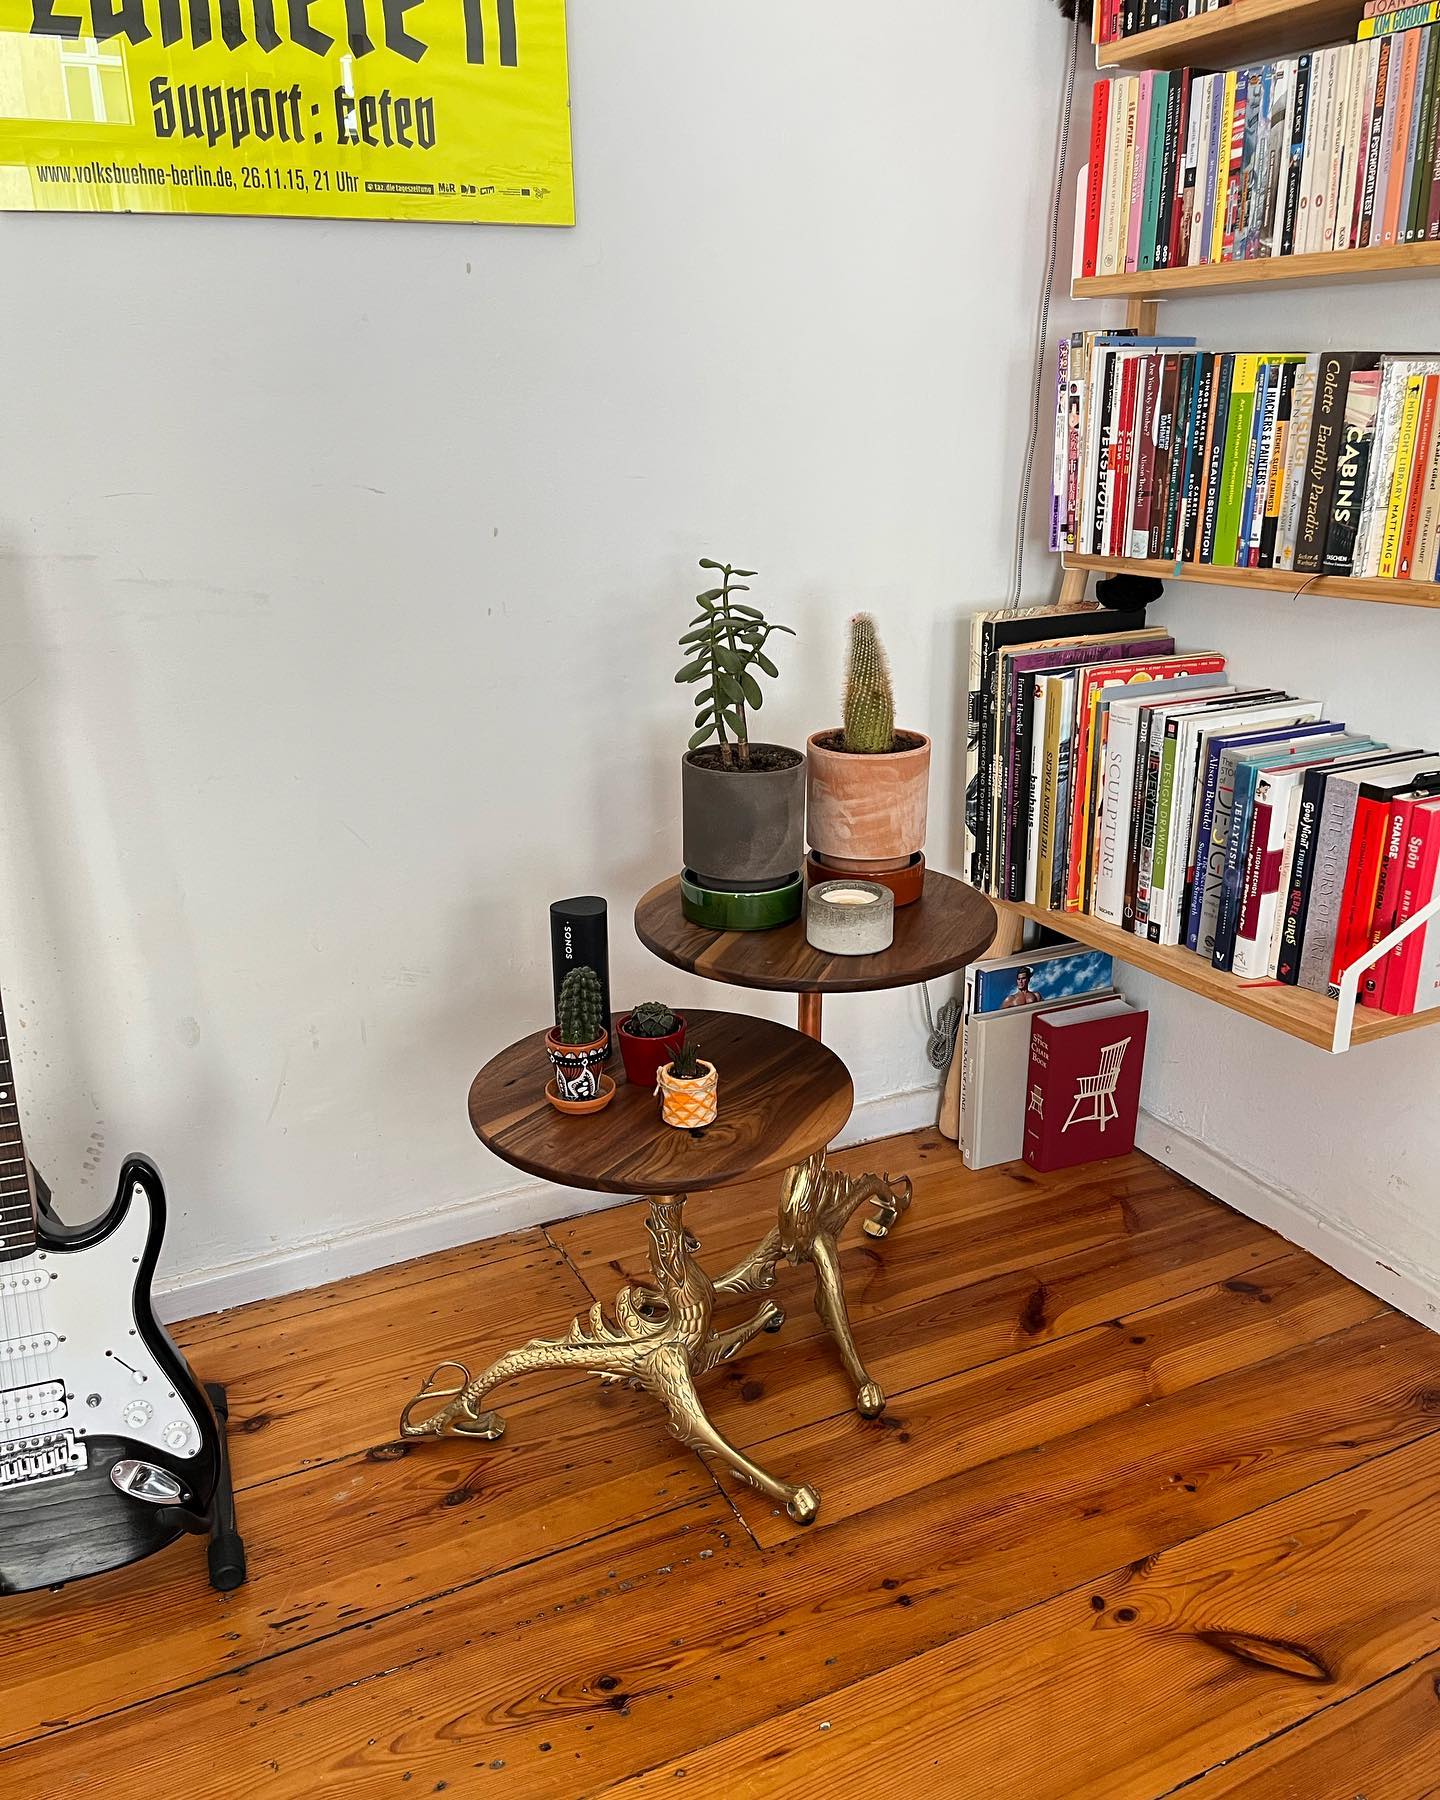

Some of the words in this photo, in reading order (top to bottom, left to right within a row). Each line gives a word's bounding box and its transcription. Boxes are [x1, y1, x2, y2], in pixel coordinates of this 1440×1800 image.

[1375, 14, 1391, 35] KIM
[1393, 4, 1430, 30] GORDON
[1379, 42, 1390, 64] JON
[1375, 63, 1388, 107] RONSON
[1094, 109, 1102, 149] FRANCK
[1295, 115, 1303, 134] DICK
[1372, 116, 1382, 133] THE
[37, 161, 237, 191] www.volksbuehne-berlin.de,
[241, 167, 309, 197] 26.11.15,
[313, 170, 331, 191] 21
[336, 171, 359, 192] Uhr
[1365, 135, 1379, 194] PSYCHOPATH
[1363, 195, 1373, 215] TEST
[1147, 376, 1155, 390] You
[1148, 362, 1156, 375] Are
[1220, 361, 1229, 388] TONY
[1145, 390, 1153, 405] My
[1202, 372, 1212, 407] HUNGER
[1319, 358, 1340, 414] Colette
[1142, 405, 1152, 437] Mother?
[1166, 413, 1172, 424] MY
[1194, 389, 1203, 427] MODERN
[1260, 390, 1276, 432] HACKERS
[1289, 373, 1304, 440] SILENCE
[1291, 371, 1317, 468] KINTSUGI
[1424, 398, 1432, 421] DANIEL
[1156, 414, 1168, 449] DAHMER
[1162, 424, 1171, 451] FRIEND
[1191, 429, 1199, 450] GIRL
[1198, 411, 1207, 441] MAKES
[1260, 433, 1269, 442] &
[1273, 426, 1283, 455] WITCHES,
[1399, 399, 1416, 455] MIDNIGHT
[1116, 430, 1124, 460] MAUS
[1196, 443, 1203, 456] ME
[1233, 431, 1242, 459] Visual
[1248, 438, 1258, 462] SECRET
[1309, 423, 1332, 480] Earthly
[1418, 422, 1429, 461] KAHNEMAN
[1093, 425, 1111, 531] PERSEPOLIS
[1138, 453, 1149, 478] Alison
[1209, 445, 1220, 485] CLEAN
[1254, 442, 1271, 486] PAINTERS
[1270, 456, 1279, 477] SLUTS,
[1285, 454, 1293, 481] THICH
[1332, 427, 1363, 523] CABINS
[1392, 456, 1407, 500] LIBRARY
[1429, 466, 1438, 491] Güzel
[1134, 478, 1146, 508] Bechdel
[1226, 460, 1238, 506] Perception
[1266, 478, 1276, 512] FEMINISTS
[1282, 482, 1290, 504] NHAT
[1183, 473, 1196, 528] BROWNSTEIN
[1191, 486, 1199, 516] CARRIE
[1302, 482, 1324, 543] Paradise
[1409, 496, 1417, 513] FAST
[1201, 487, 1215, 556] DISRUPTION
[1387, 503, 1400, 531] MATT
[1383, 533, 1395, 560] HAIG
[1404, 529, 1412, 546] SLOW
[982, 693, 988, 702] IN
[1016, 677, 1024, 701] Ernst
[1014, 703, 1025, 735] Haeckel
[1140, 722, 1148, 742] DDR
[980, 759, 986, 770] OF
[980, 772, 985, 784] NO
[1012, 762, 1020, 788] Forms
[1044, 750, 1052, 791] TRACKS
[1206, 753, 1218, 787] Alison
[1160, 762, 1171, 806] DESIGN
[1011, 800, 1019, 828] Nature
[1026, 775, 1038, 827] bauhaus
[1042, 794, 1050, 835] HIDDEN
[1101, 750, 1122, 878] SCULPTURE
[1142, 760, 1159, 846] EVERYTHING
[1201, 790, 1214, 830] Bechdel
[1328, 801, 1345, 834] THE
[1155, 810, 1167, 865] DRAWING
[1205, 784, 1233, 902] DESIGN
[1226, 801, 1243, 869] JELLYFISH
[1387, 815, 1404, 859] CHANGE
[1193, 840, 1205, 885] Superhuman
[1253, 846, 1264, 870] ALISON
[1319, 844, 1339, 897] STORY
[1380, 854, 1390, 870] BY
[1248, 870, 1260, 898] BECHDEL
[1373, 871, 1388, 910] DESIGN
[1189, 885, 1200, 916] Strength
[1288, 888, 1302, 916] REBEL
[1315, 903, 1331, 928] OF
[565, 926, 573, 959] SONOS
[1283, 916, 1299, 945] GIRLS
[1372, 930, 1380, 942] TIM
[1310, 930, 1327, 962] ART
[1031, 1042, 1049, 1060] CHAIR
[1032, 1034, 1049, 1050] STICK
[1032, 1052, 1048, 1069] BOOK
